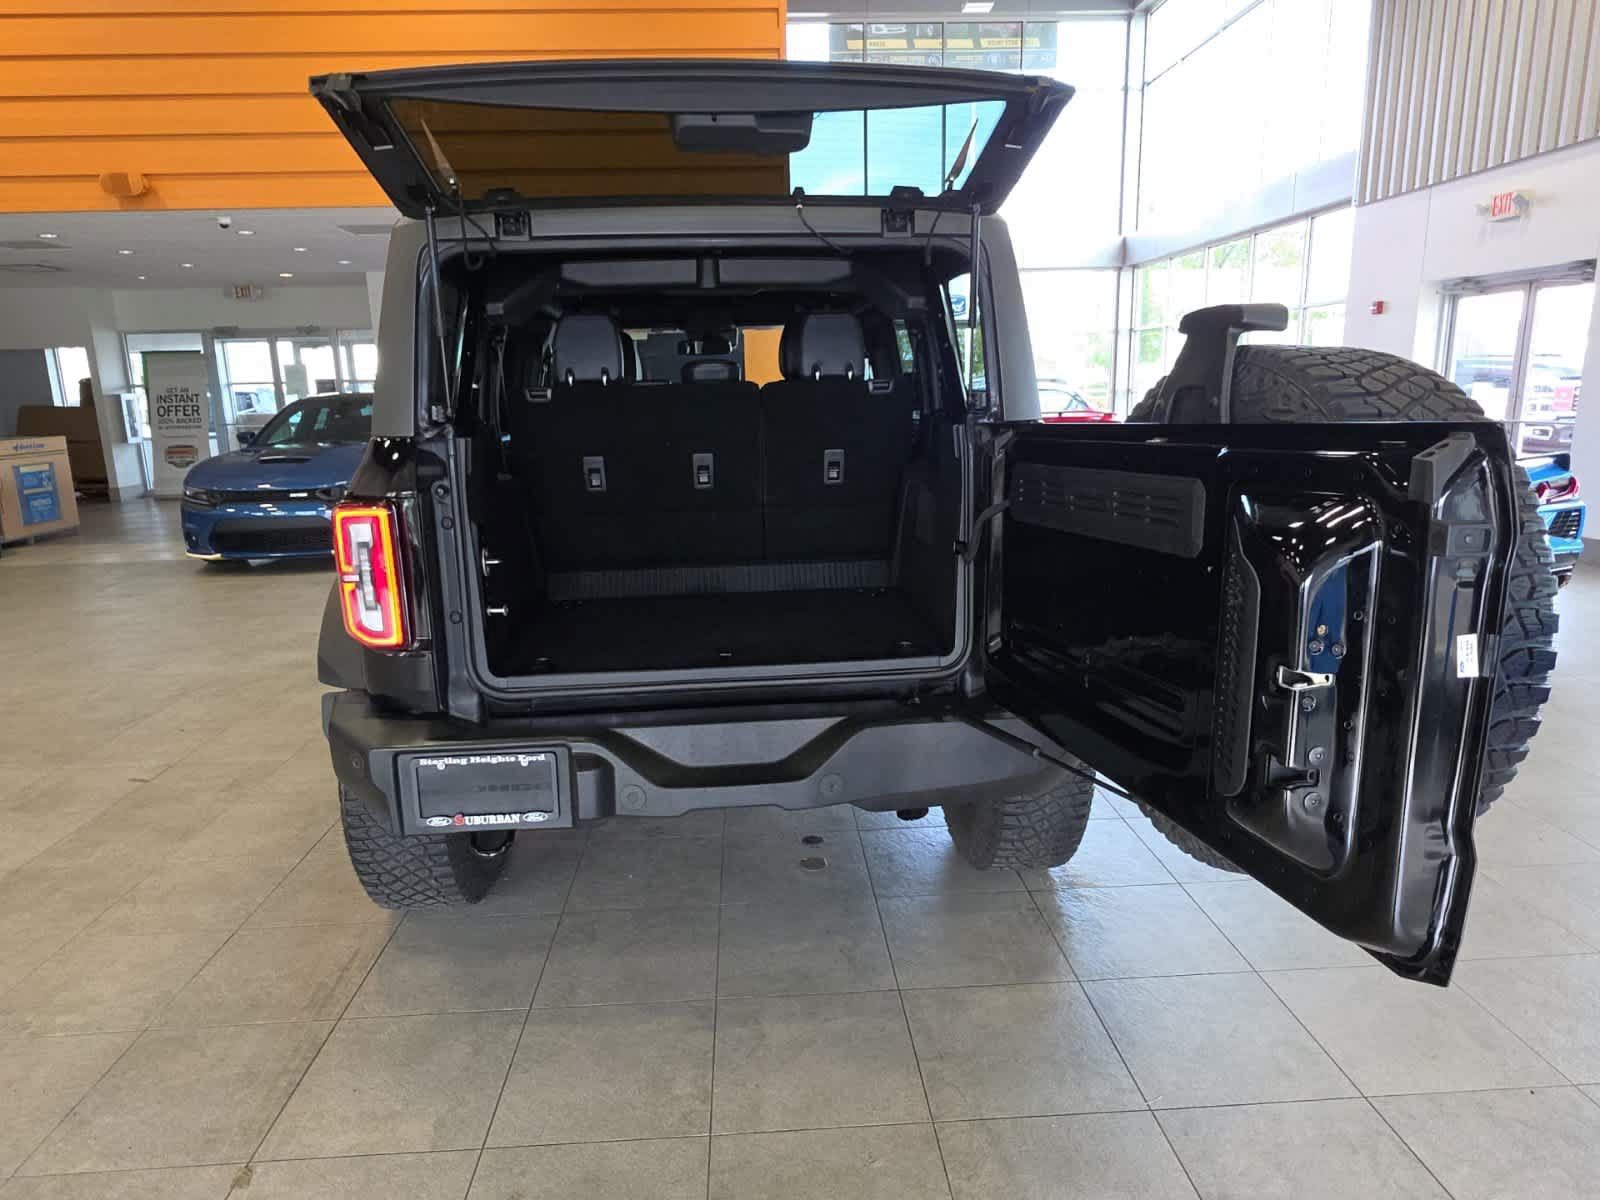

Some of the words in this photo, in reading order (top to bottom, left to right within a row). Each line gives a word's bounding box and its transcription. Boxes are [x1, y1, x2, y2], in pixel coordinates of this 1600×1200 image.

[1492, 192, 1513, 217] EXIT
[156, 393, 200, 404] INSTANT
[157, 404, 201, 417] OFFER
[470, 755, 516, 764] Heights
[455, 814, 521, 826] SUBURBAN
